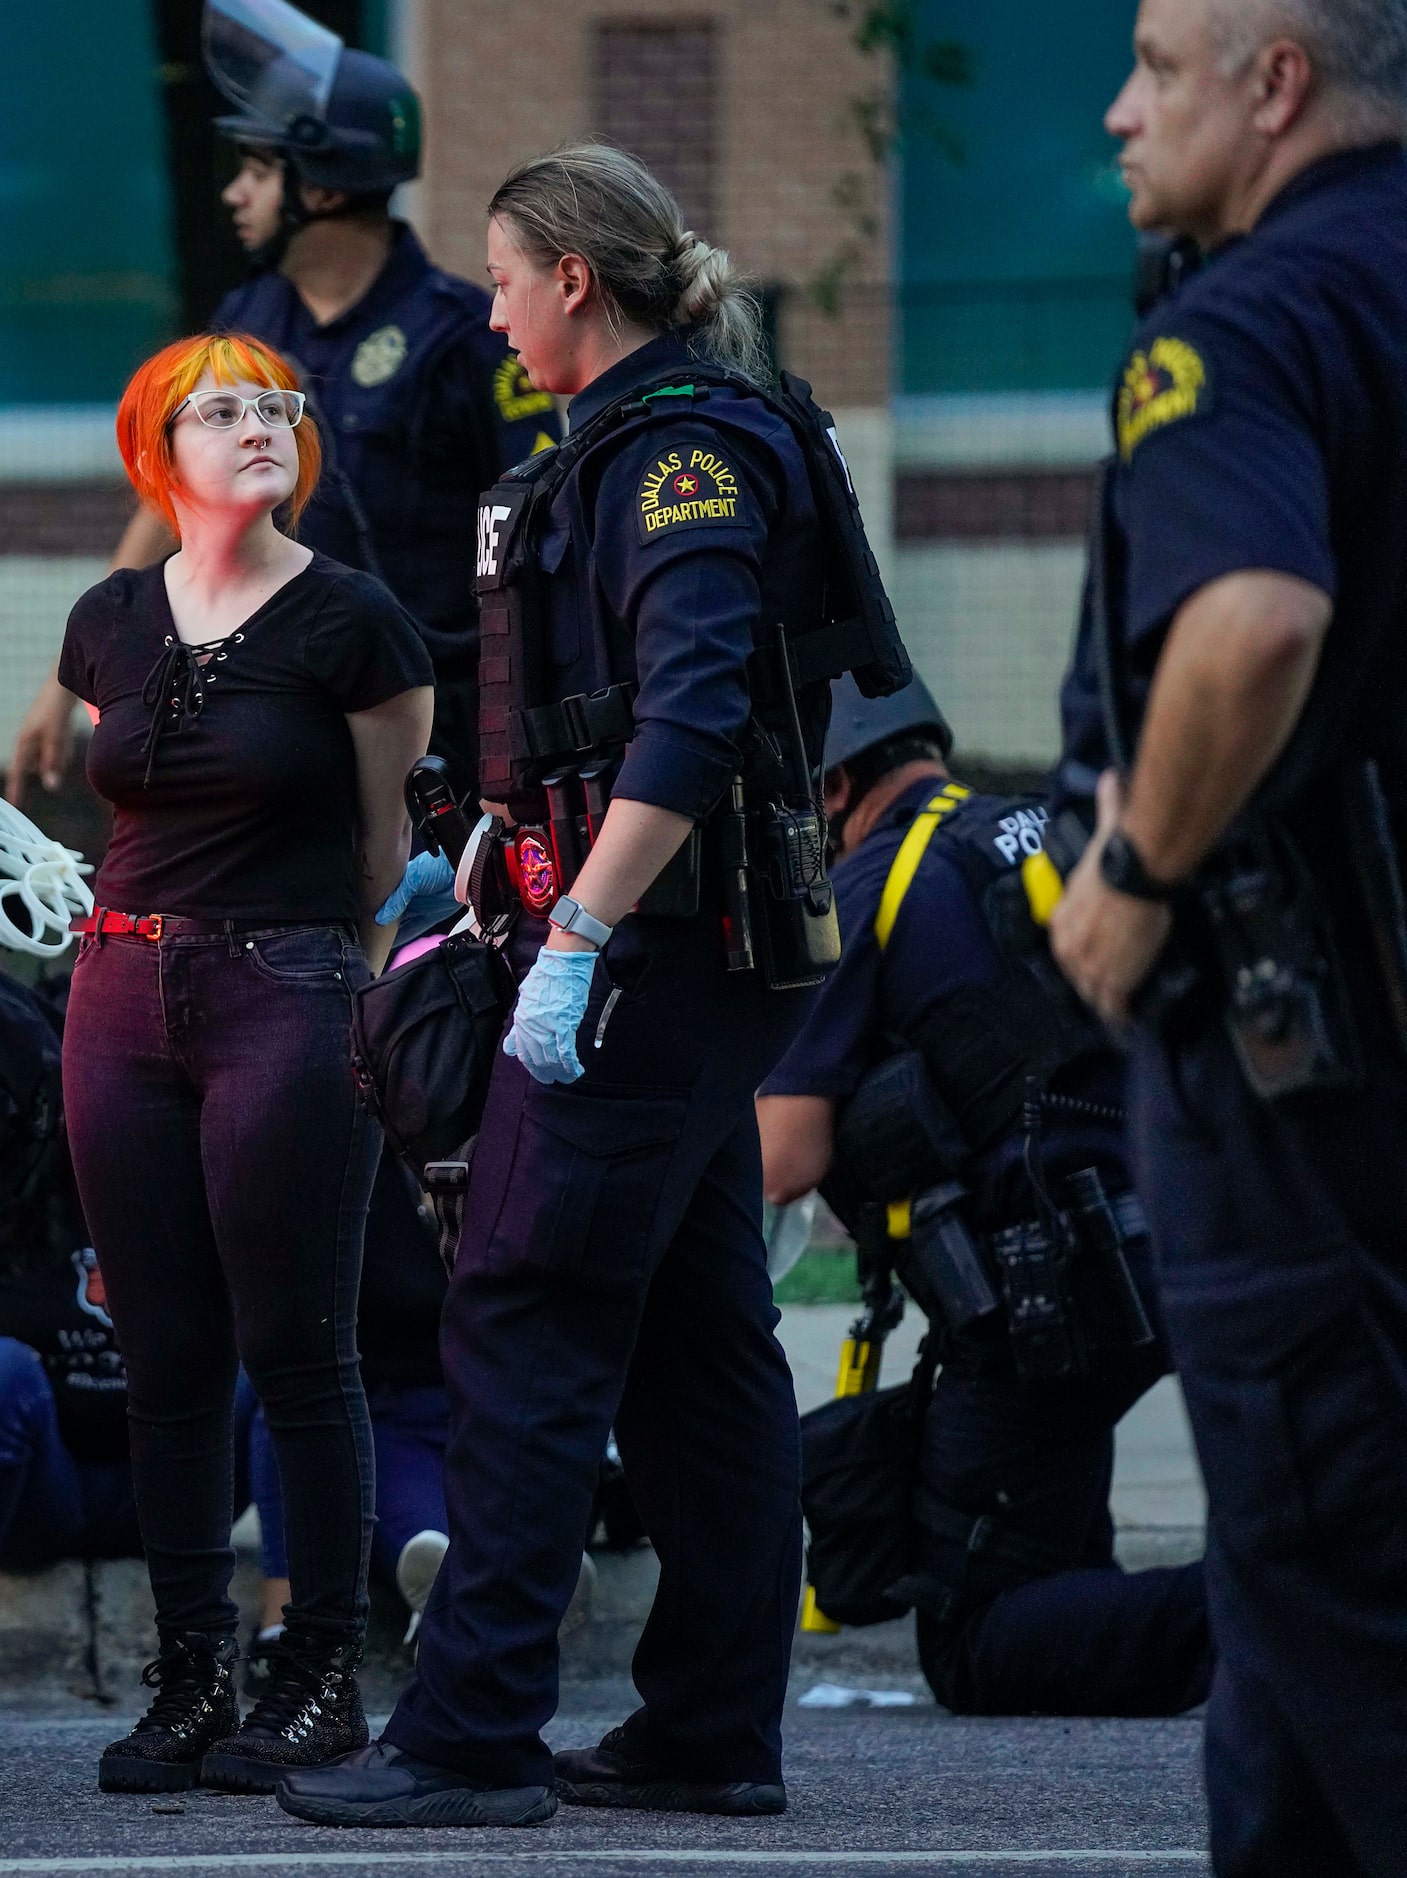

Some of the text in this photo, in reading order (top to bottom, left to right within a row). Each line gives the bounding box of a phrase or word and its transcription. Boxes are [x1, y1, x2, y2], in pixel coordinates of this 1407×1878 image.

[640, 449, 739, 512] DALLAS POLICE
[645, 498, 736, 532] DEPARTMENT
